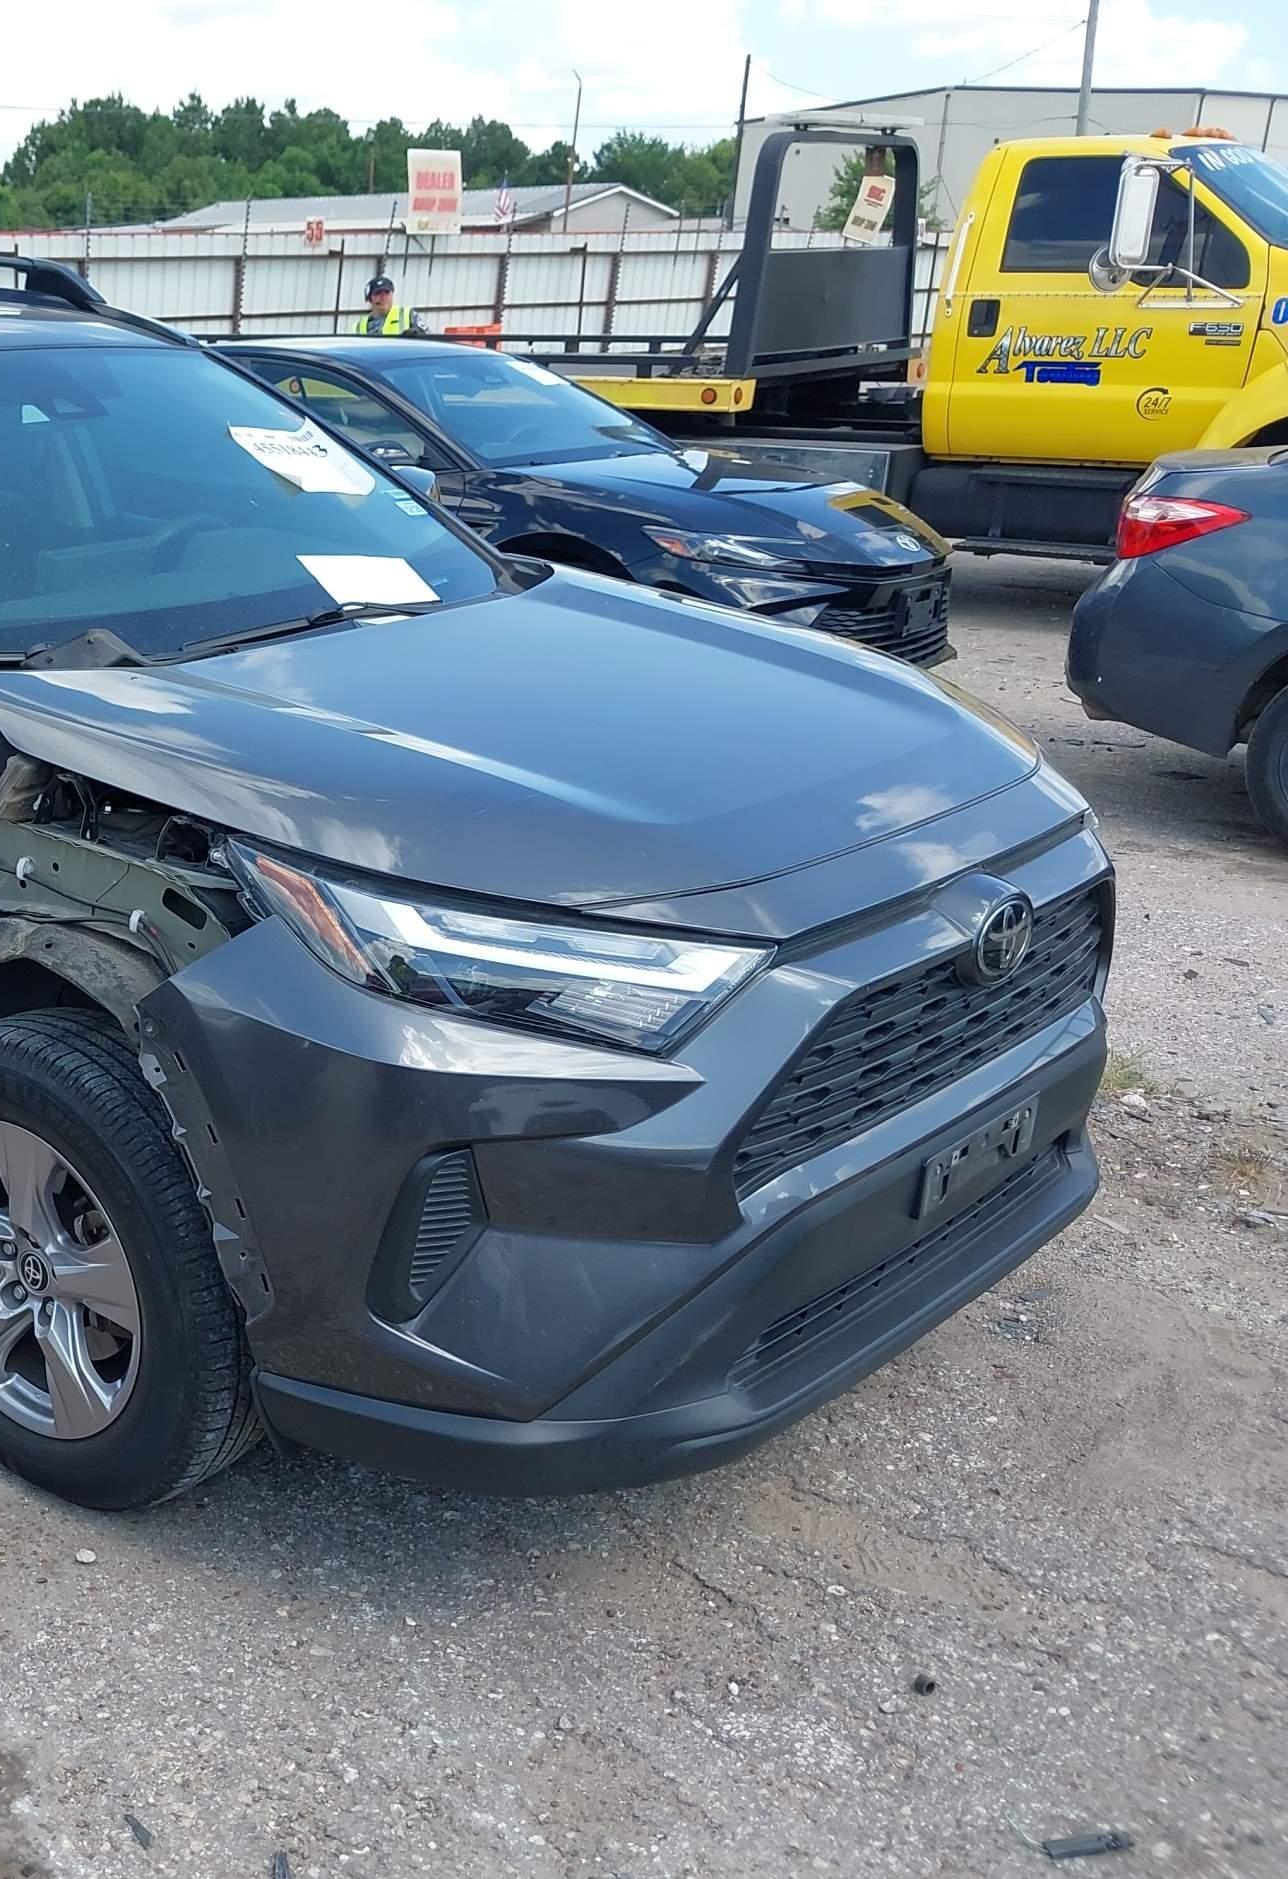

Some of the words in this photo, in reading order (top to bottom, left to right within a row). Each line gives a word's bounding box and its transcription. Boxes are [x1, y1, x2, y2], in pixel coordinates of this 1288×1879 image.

[1197, 150, 1226, 171] IN
[976, 326, 1087, 374] Alvarez
[1088, 327, 1153, 359] LLC
[1143, 396, 1172, 409] 24/7
[1143, 408, 1169, 416] SERVICE
